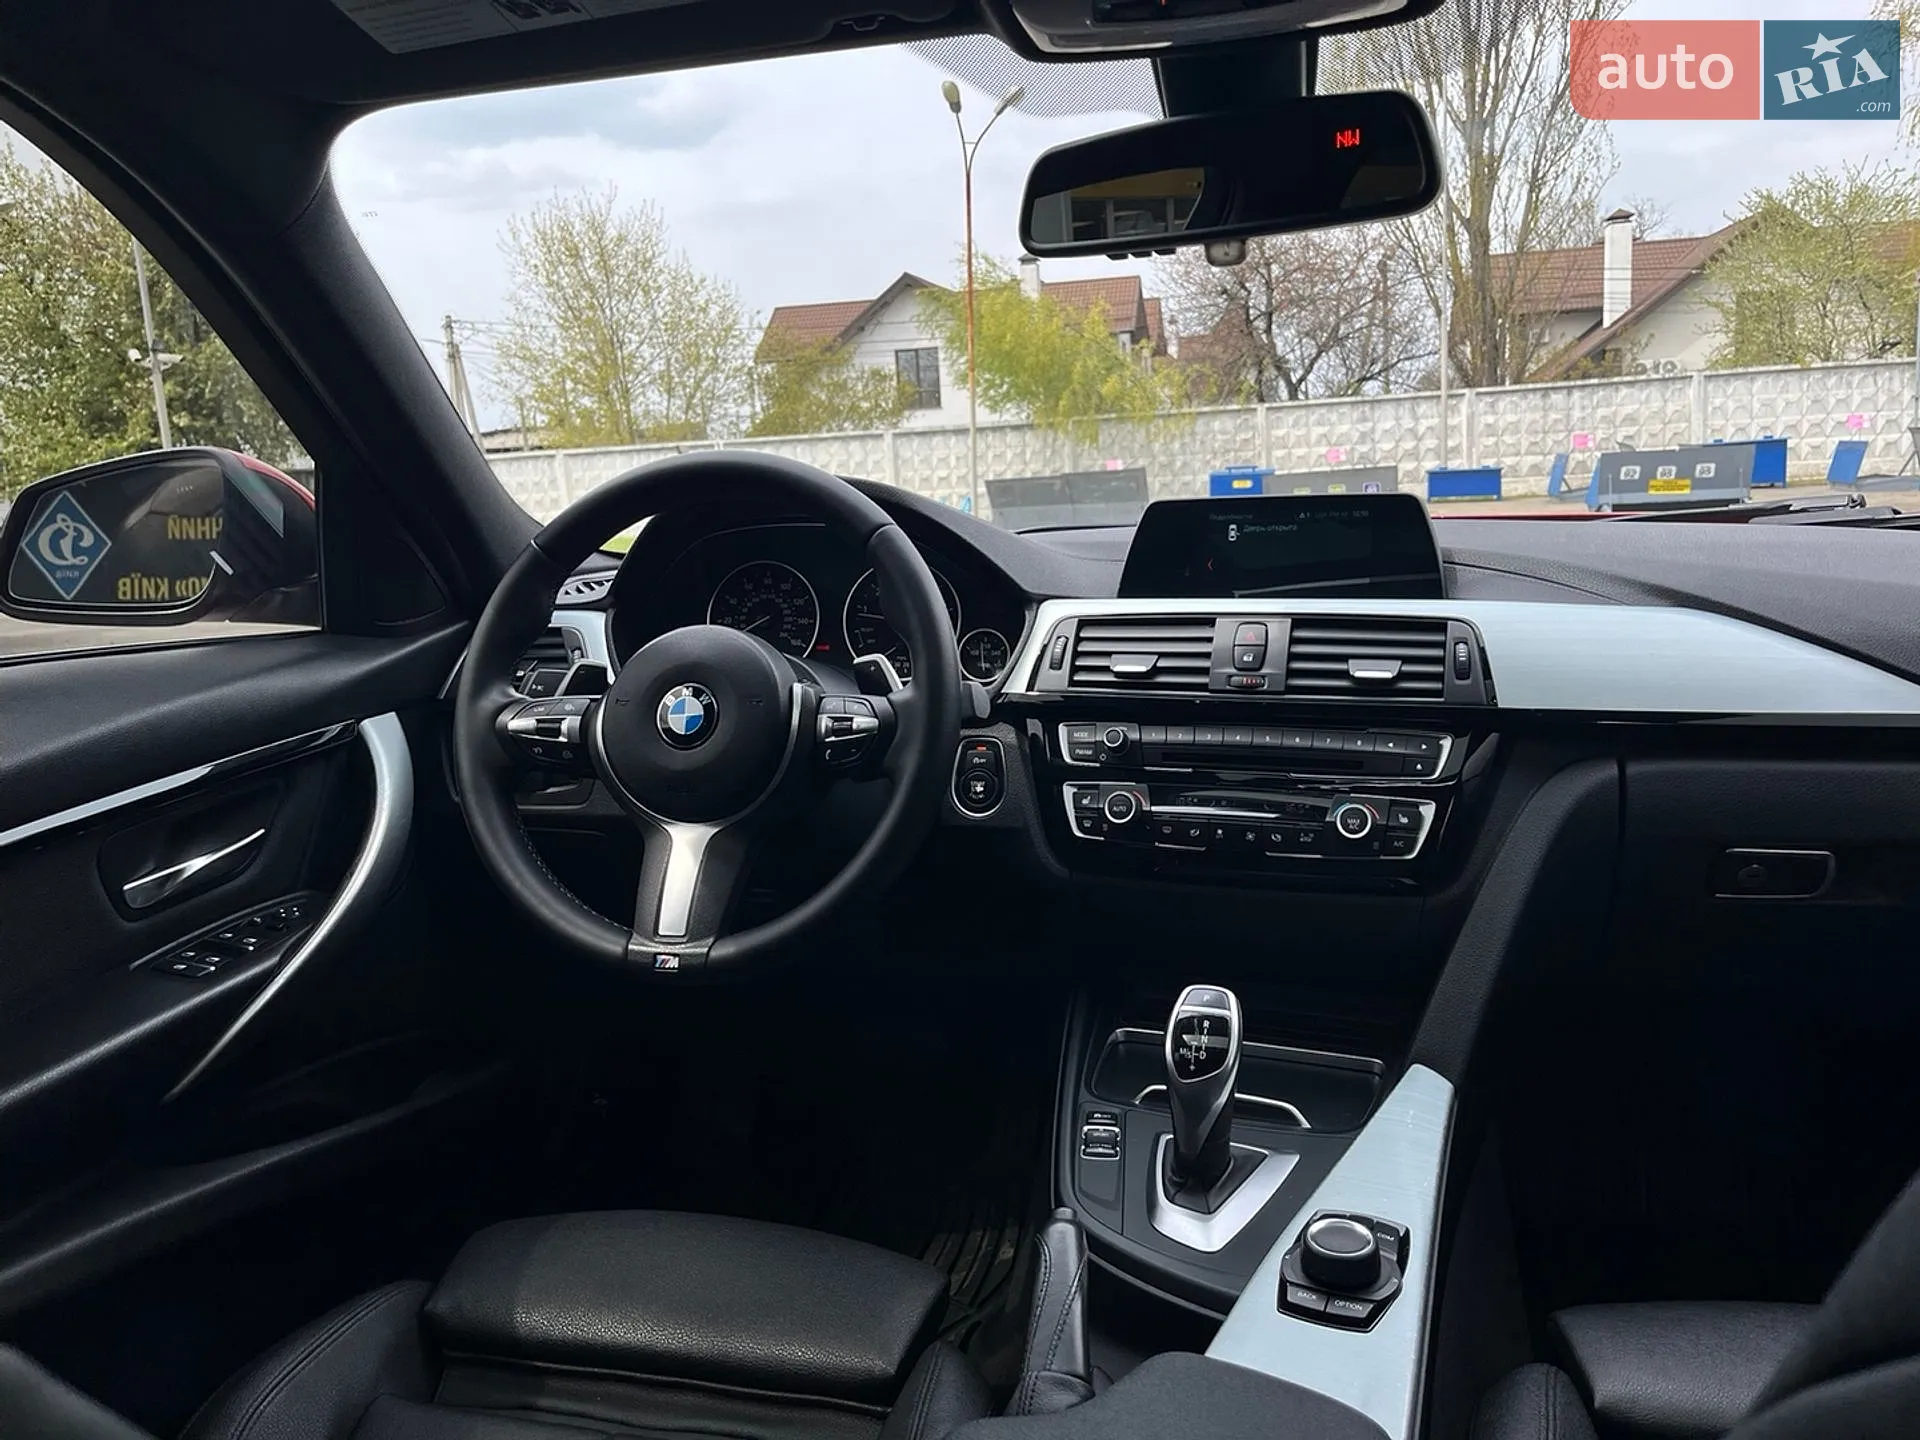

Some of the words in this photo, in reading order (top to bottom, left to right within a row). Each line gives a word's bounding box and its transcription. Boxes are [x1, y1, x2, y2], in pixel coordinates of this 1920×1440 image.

[1336, 128, 1360, 148] NW
[665, 686, 712, 706] BMW
[1203, 994, 1210, 1002] P
[1203, 1019, 1211, 1029] R
[1201, 1034, 1208, 1044] N
[1199, 1050, 1207, 1060] D
[1297, 1291, 1316, 1300] BACK
[1334, 1299, 1363, 1311] OPTION
